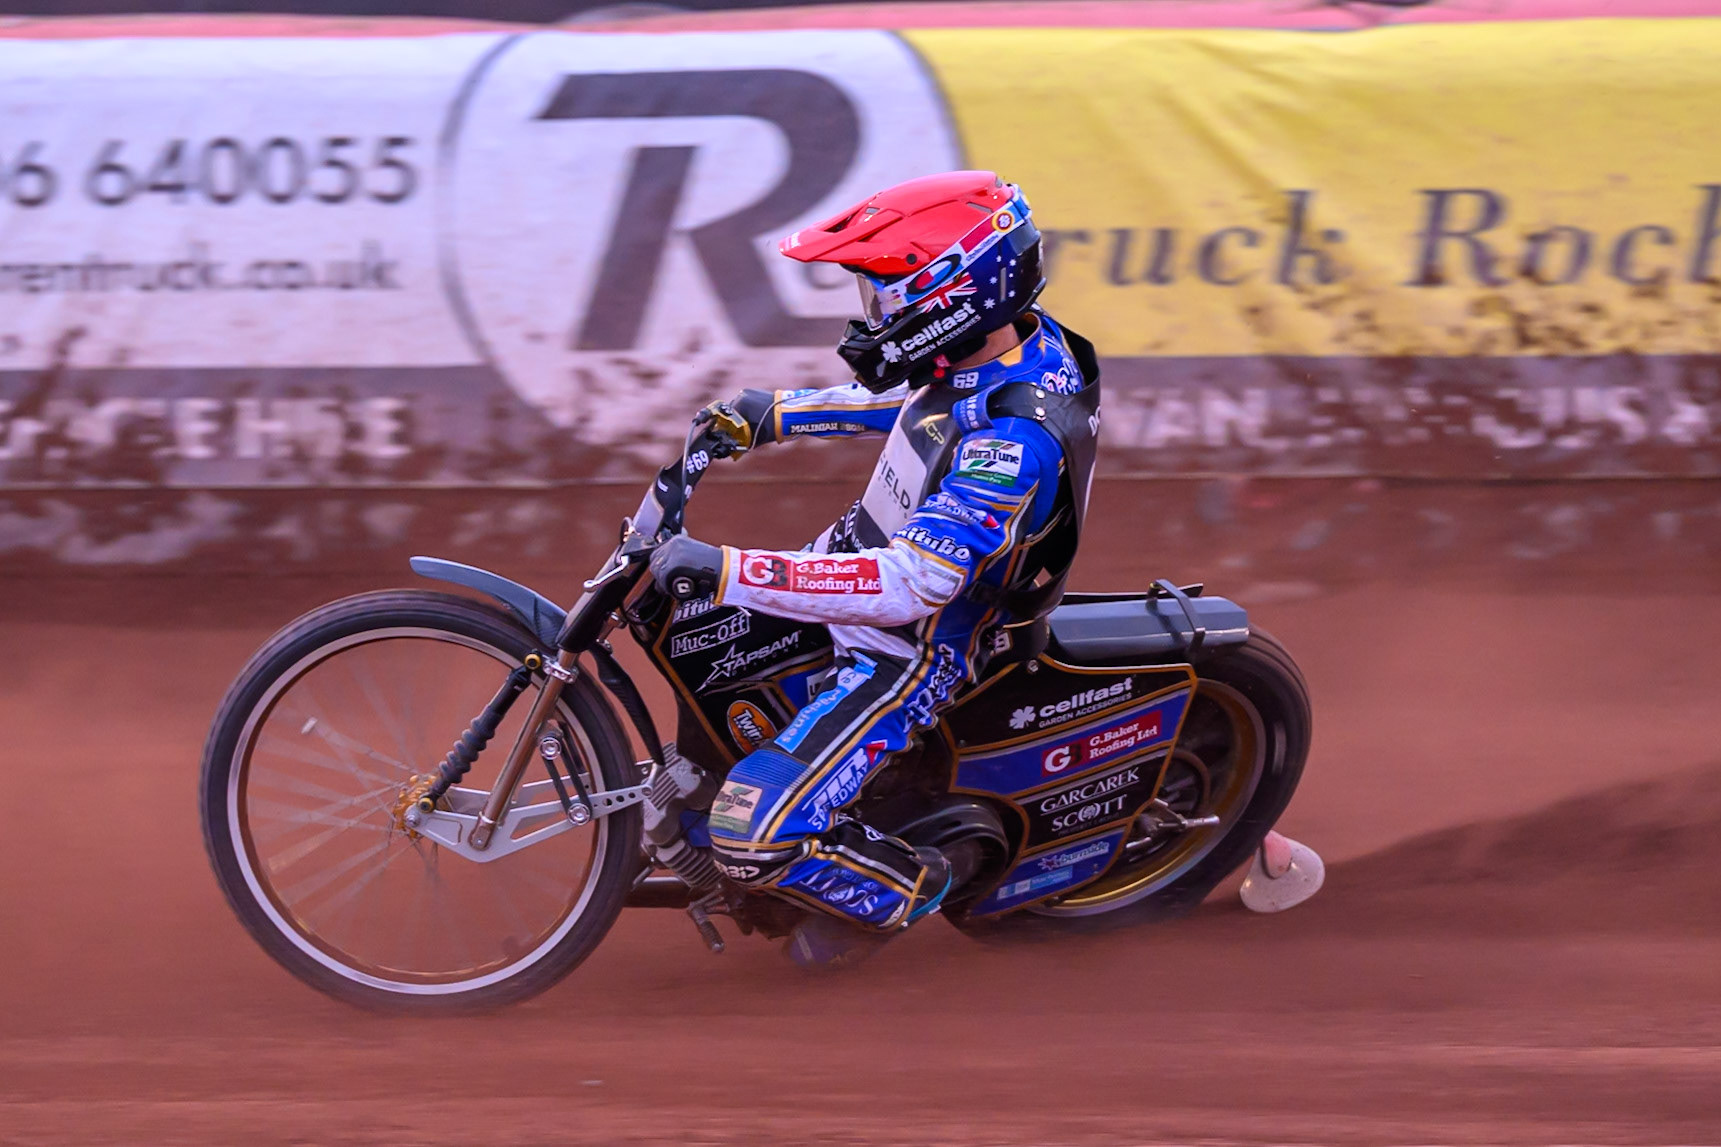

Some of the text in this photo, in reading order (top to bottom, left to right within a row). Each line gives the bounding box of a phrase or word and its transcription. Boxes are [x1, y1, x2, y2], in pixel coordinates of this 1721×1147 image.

[84, 136, 419, 207] 640055
[1043, 188, 1350, 289] ruck
[901, 302, 976, 351] cellfast
[908, 343, 937, 361] GARDEN
[953, 371, 979, 388] 69
[686, 450, 709, 475] #69
[879, 450, 911, 510] IELD
[796, 562, 860, 575] G.Baker
[796, 575, 856, 594] Roofing
[675, 615, 747, 654] Muc-Off
[1038, 692, 1133, 728] GARDEN ACCESSORIES
[1039, 676, 1133, 717] cellfast
[1089, 723, 1139, 747] G.Baker
[1089, 725, 1158, 760] Roofing Ltd
[1040, 767, 1139, 813] GARCAREK
